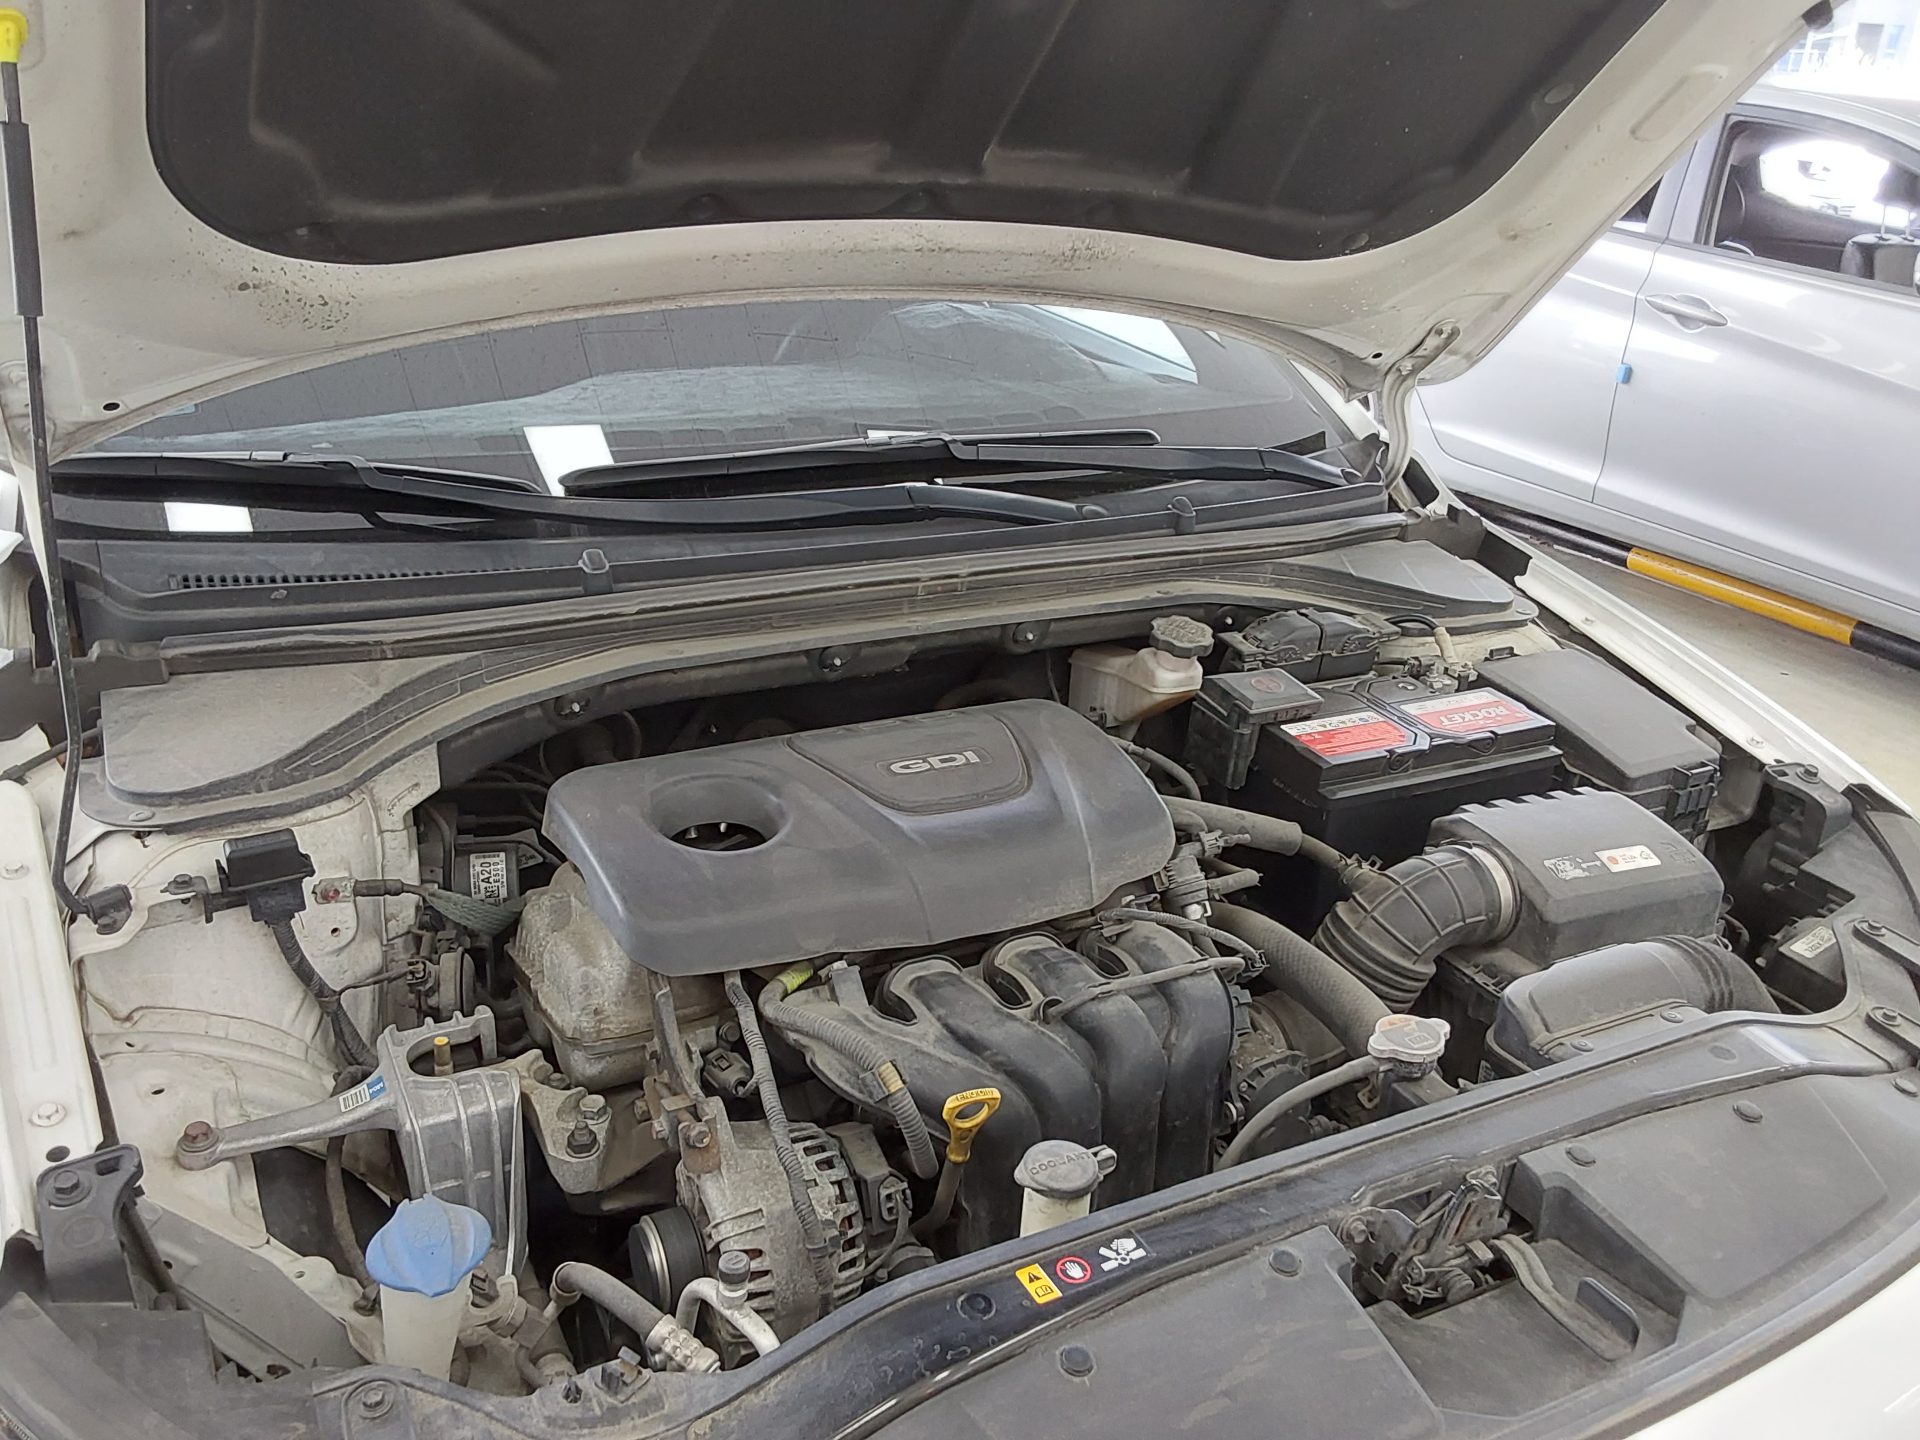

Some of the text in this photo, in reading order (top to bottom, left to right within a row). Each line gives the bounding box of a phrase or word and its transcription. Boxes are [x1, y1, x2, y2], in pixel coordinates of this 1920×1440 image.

[1440, 705, 1508, 726] ROCKET
[890, 751, 980, 773] GDI
[481, 861, 492, 884] A20
[1029, 1151, 1092, 1176] COOLANT
